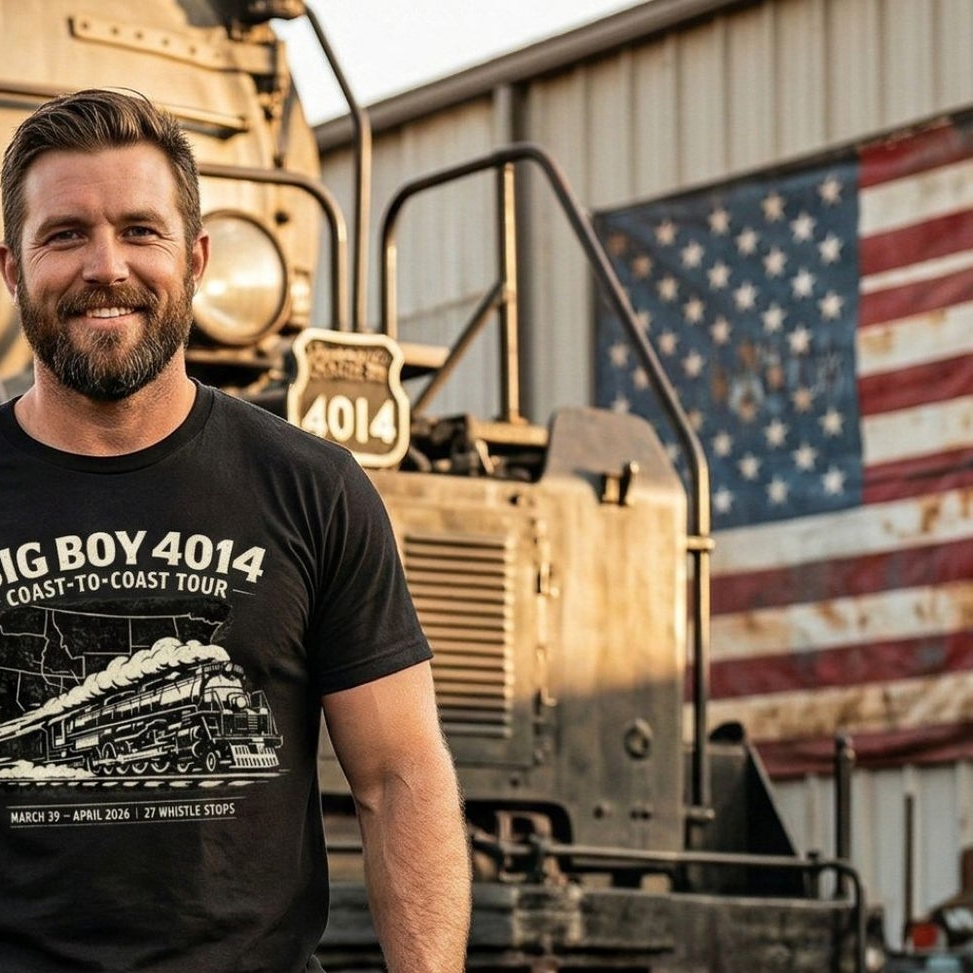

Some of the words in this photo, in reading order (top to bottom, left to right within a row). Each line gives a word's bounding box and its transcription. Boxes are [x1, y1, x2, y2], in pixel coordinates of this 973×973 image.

[301, 394, 397, 445] 4014
[55, 530, 147, 571] BOY
[151, 531, 266, 583] 4014
[6, 571, 170, 607] COAST-TO-COAST
[176, 572, 228, 599] TOUR
[10, 811, 45, 823] MARCH
[47, 811, 60, 822] 39
[73, 809, 103, 822] APRIL
[105, 808, 130, 820] 2026
[144, 806, 156, 818] 27
[159, 804, 201, 818] WHISTLE
[204, 802, 235, 816] STOPS
